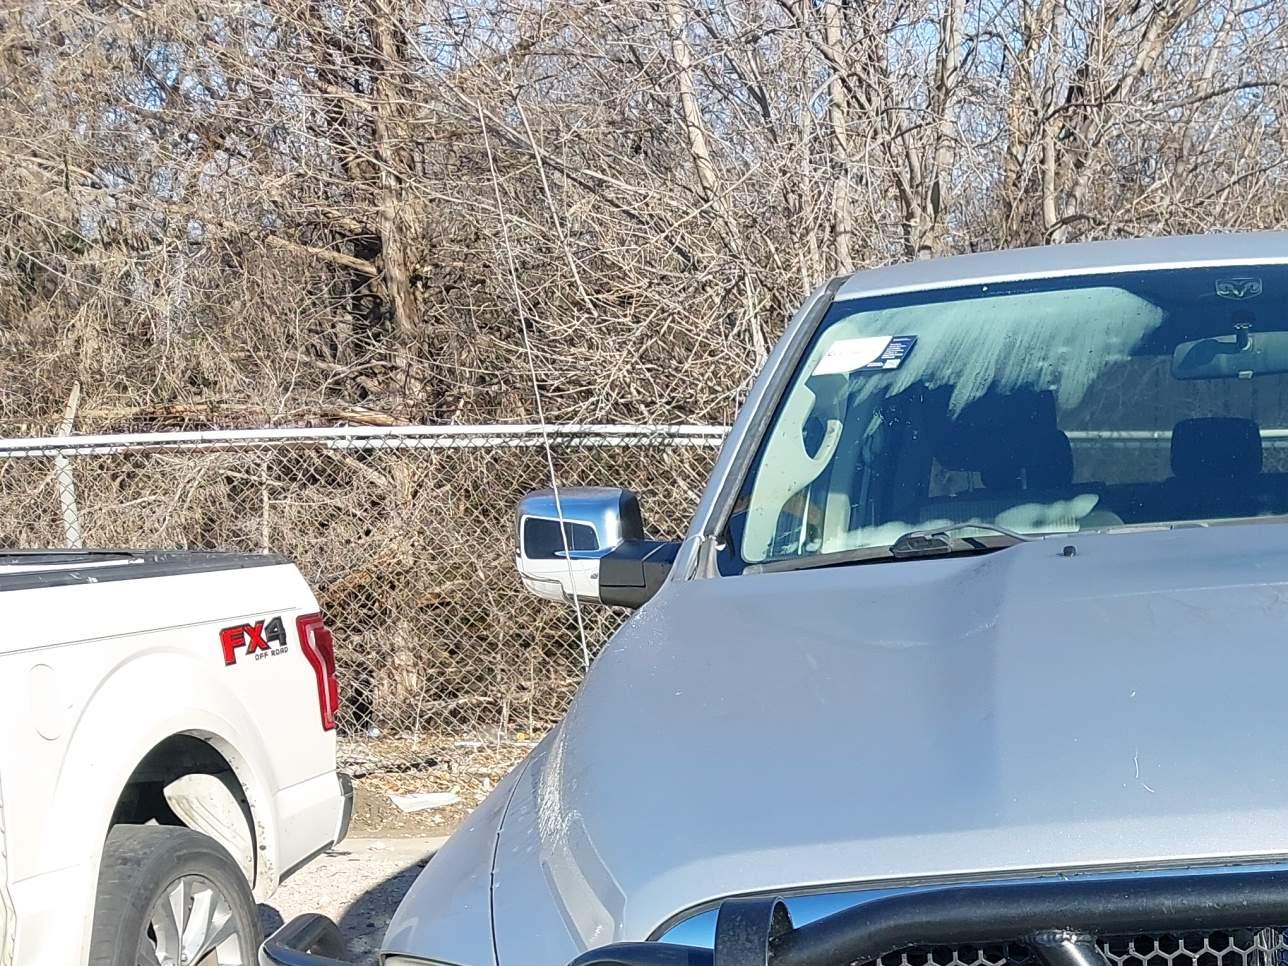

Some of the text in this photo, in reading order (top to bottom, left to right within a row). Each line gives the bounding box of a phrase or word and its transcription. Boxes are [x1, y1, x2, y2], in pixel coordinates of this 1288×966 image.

[219, 615, 287, 666] FX4
[255, 646, 289, 661] OFF ROAD
